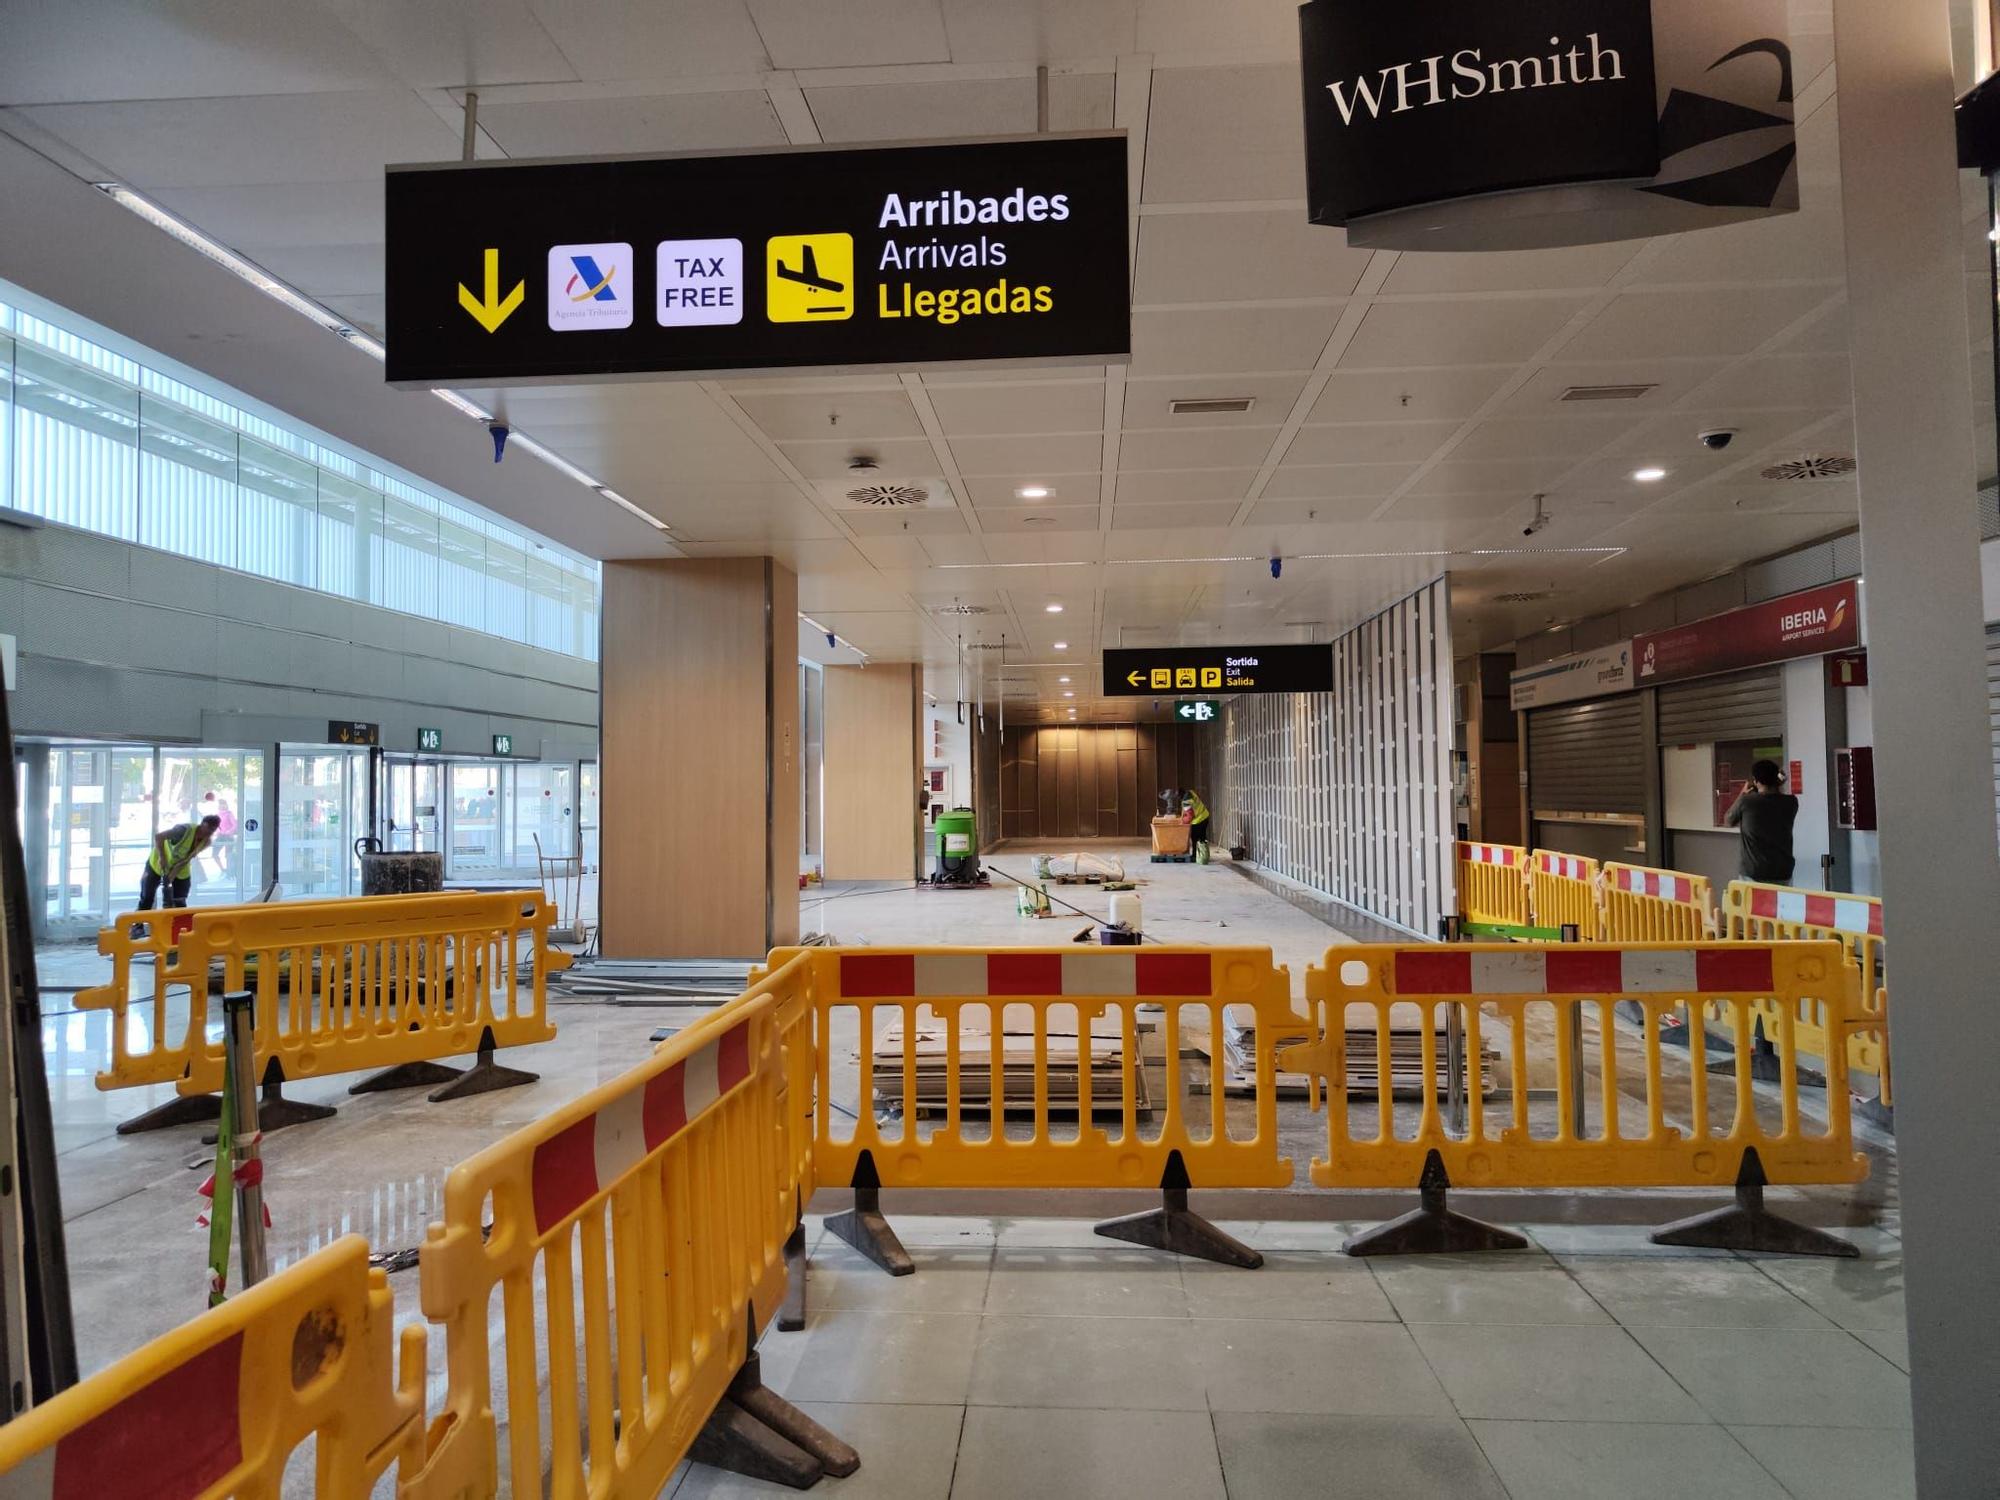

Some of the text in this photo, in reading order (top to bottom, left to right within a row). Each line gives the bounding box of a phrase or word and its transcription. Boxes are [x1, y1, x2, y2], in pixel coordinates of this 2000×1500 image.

[1326, 32, 1626, 126] WHSmith
[878, 187, 1070, 229] Arribades
[879, 235, 1007, 271] Arrivals
[674, 257, 726, 278] TAX
[665, 286, 734, 308] FREE
[879, 280, 1053, 325] Llegadas
[1781, 607, 1827, 631] IBERIA
[1782, 626, 1825, 642] AIRPORT SERVICES
[1226, 656, 1258, 666] Sortida
[1226, 667, 1241, 676] Exit
[1206, 671, 1217, 685] P
[1226, 677, 1255, 687] Salida
